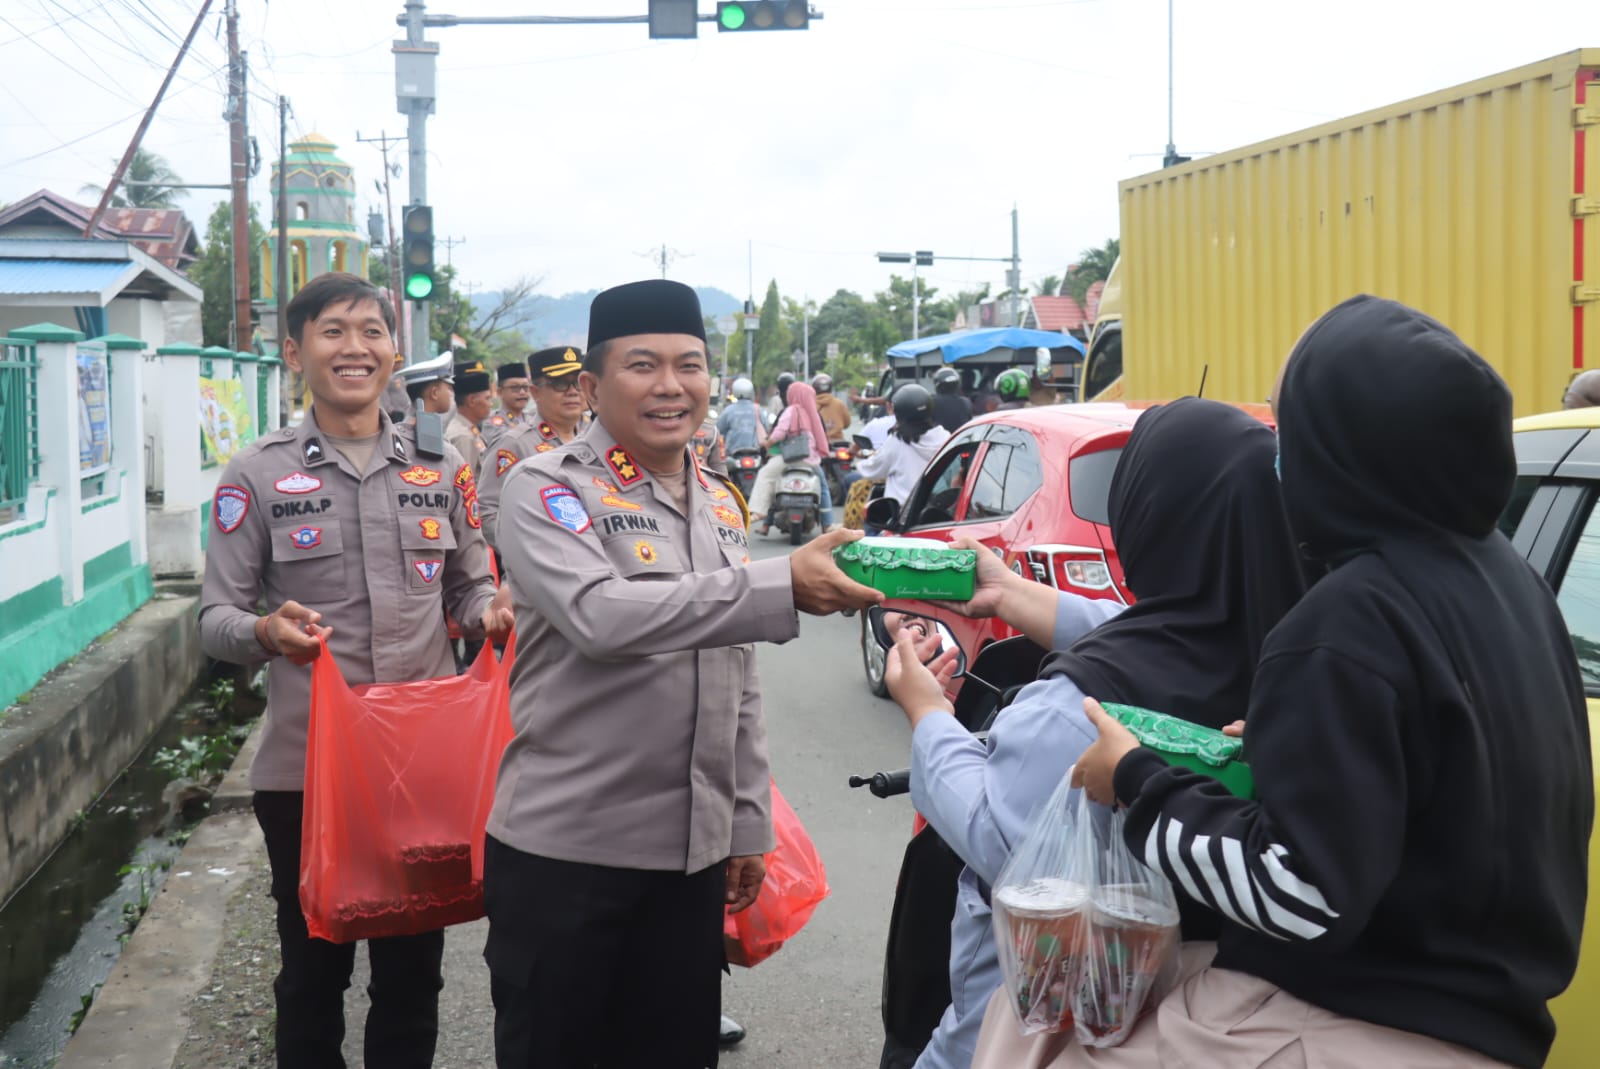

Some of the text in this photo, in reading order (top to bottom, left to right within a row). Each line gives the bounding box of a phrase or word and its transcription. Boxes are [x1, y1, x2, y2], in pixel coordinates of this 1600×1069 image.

[271, 498, 332, 518] DIKA.P
[398, 493, 449, 509] POLRI
[603, 514, 660, 535] IRWAN
